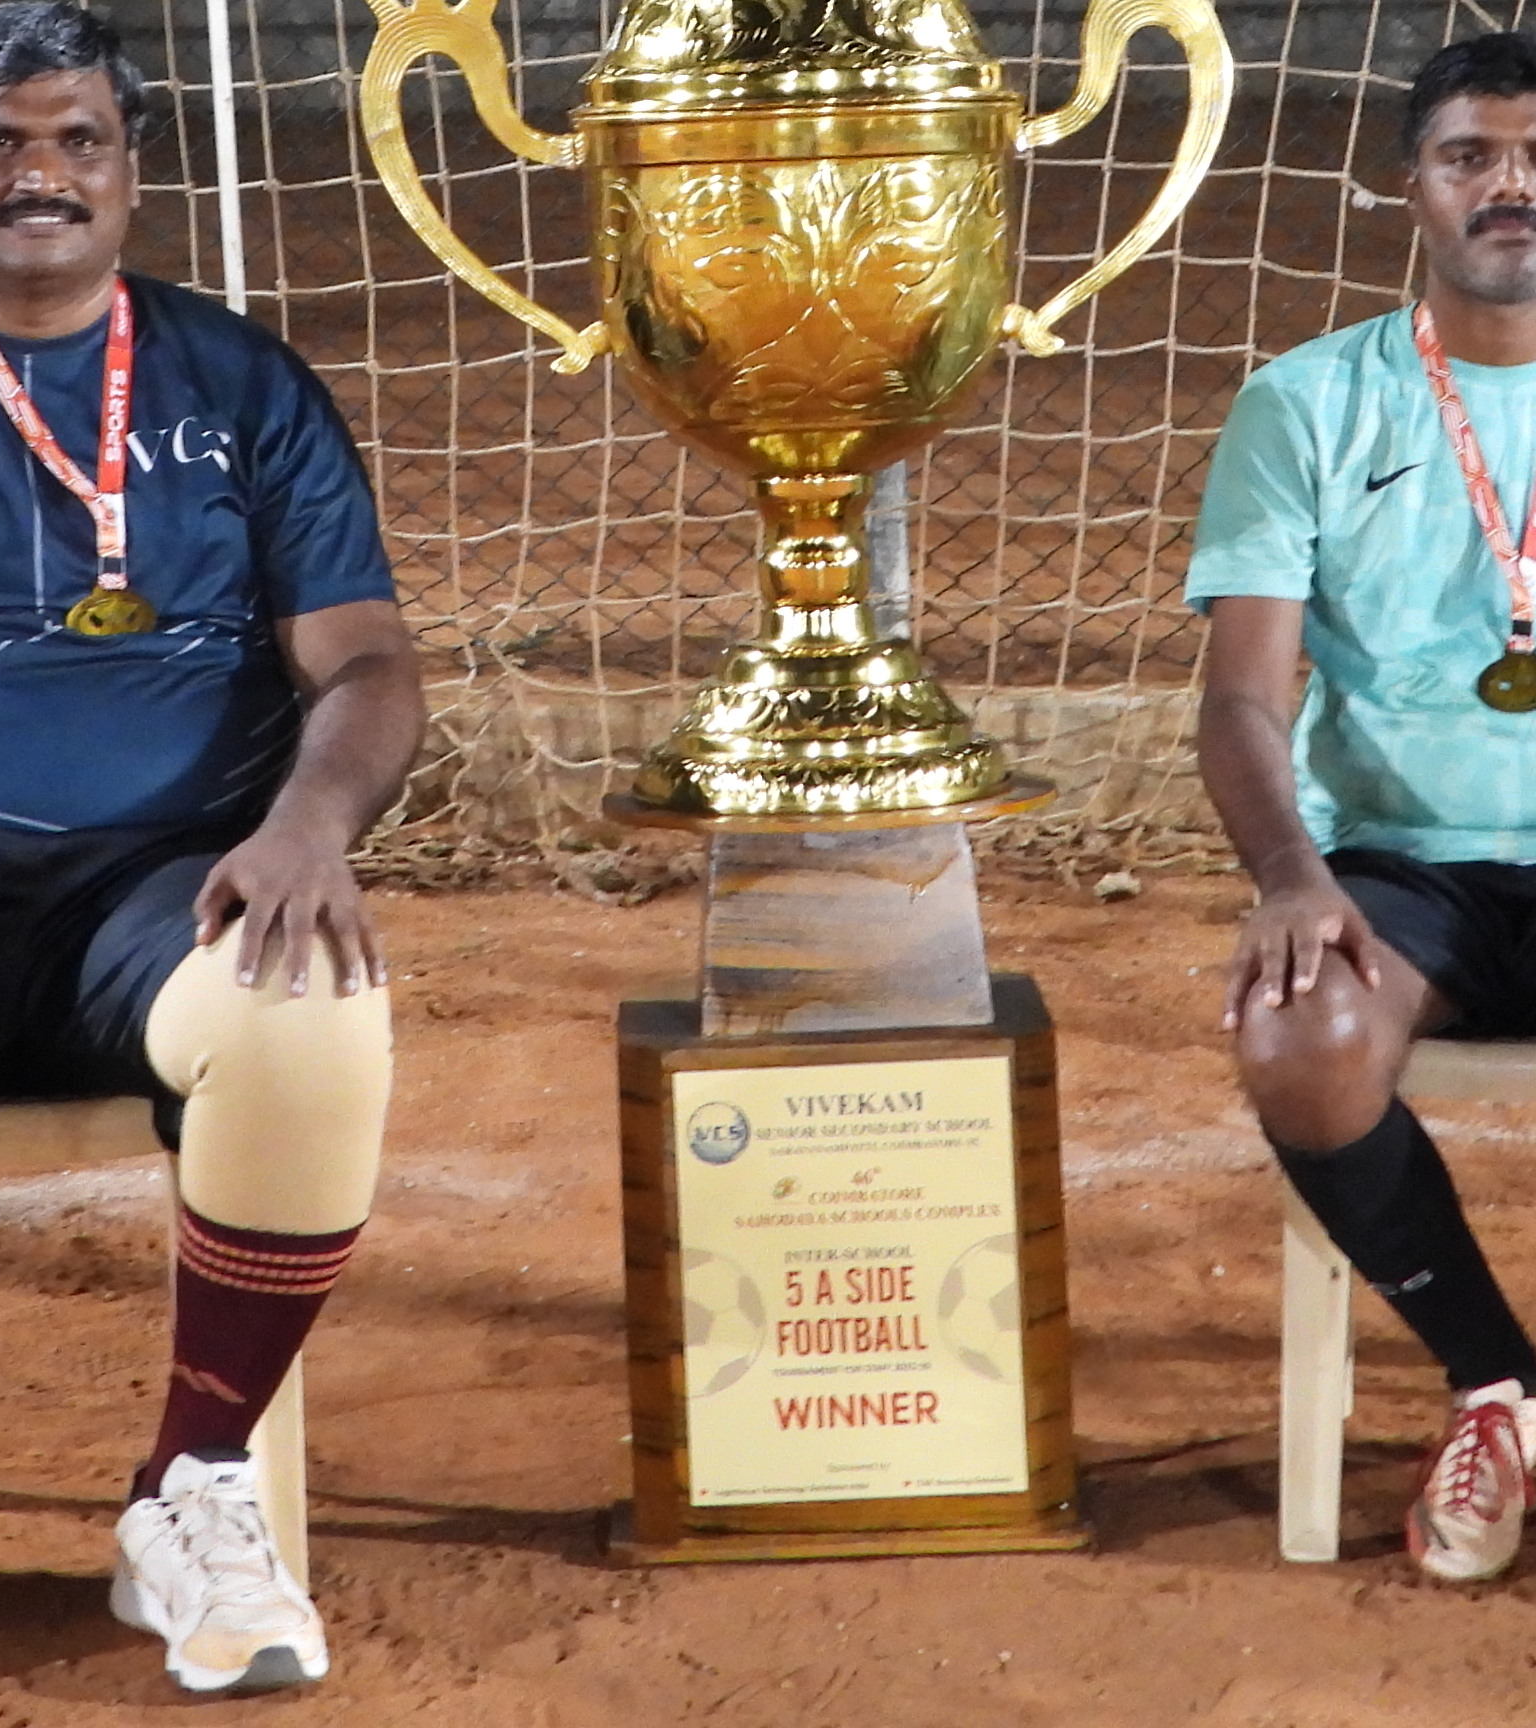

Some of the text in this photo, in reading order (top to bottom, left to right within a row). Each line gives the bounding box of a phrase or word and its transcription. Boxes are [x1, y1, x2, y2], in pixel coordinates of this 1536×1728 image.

[104, 369, 128, 462] SPORTS
[784, 1090, 924, 1117] VIVEKAM
[785, 1265, 916, 1308] 5 A SIDE
[775, 1314, 930, 1357] FOOTBALL
[773, 1390, 941, 1432] WINNER
